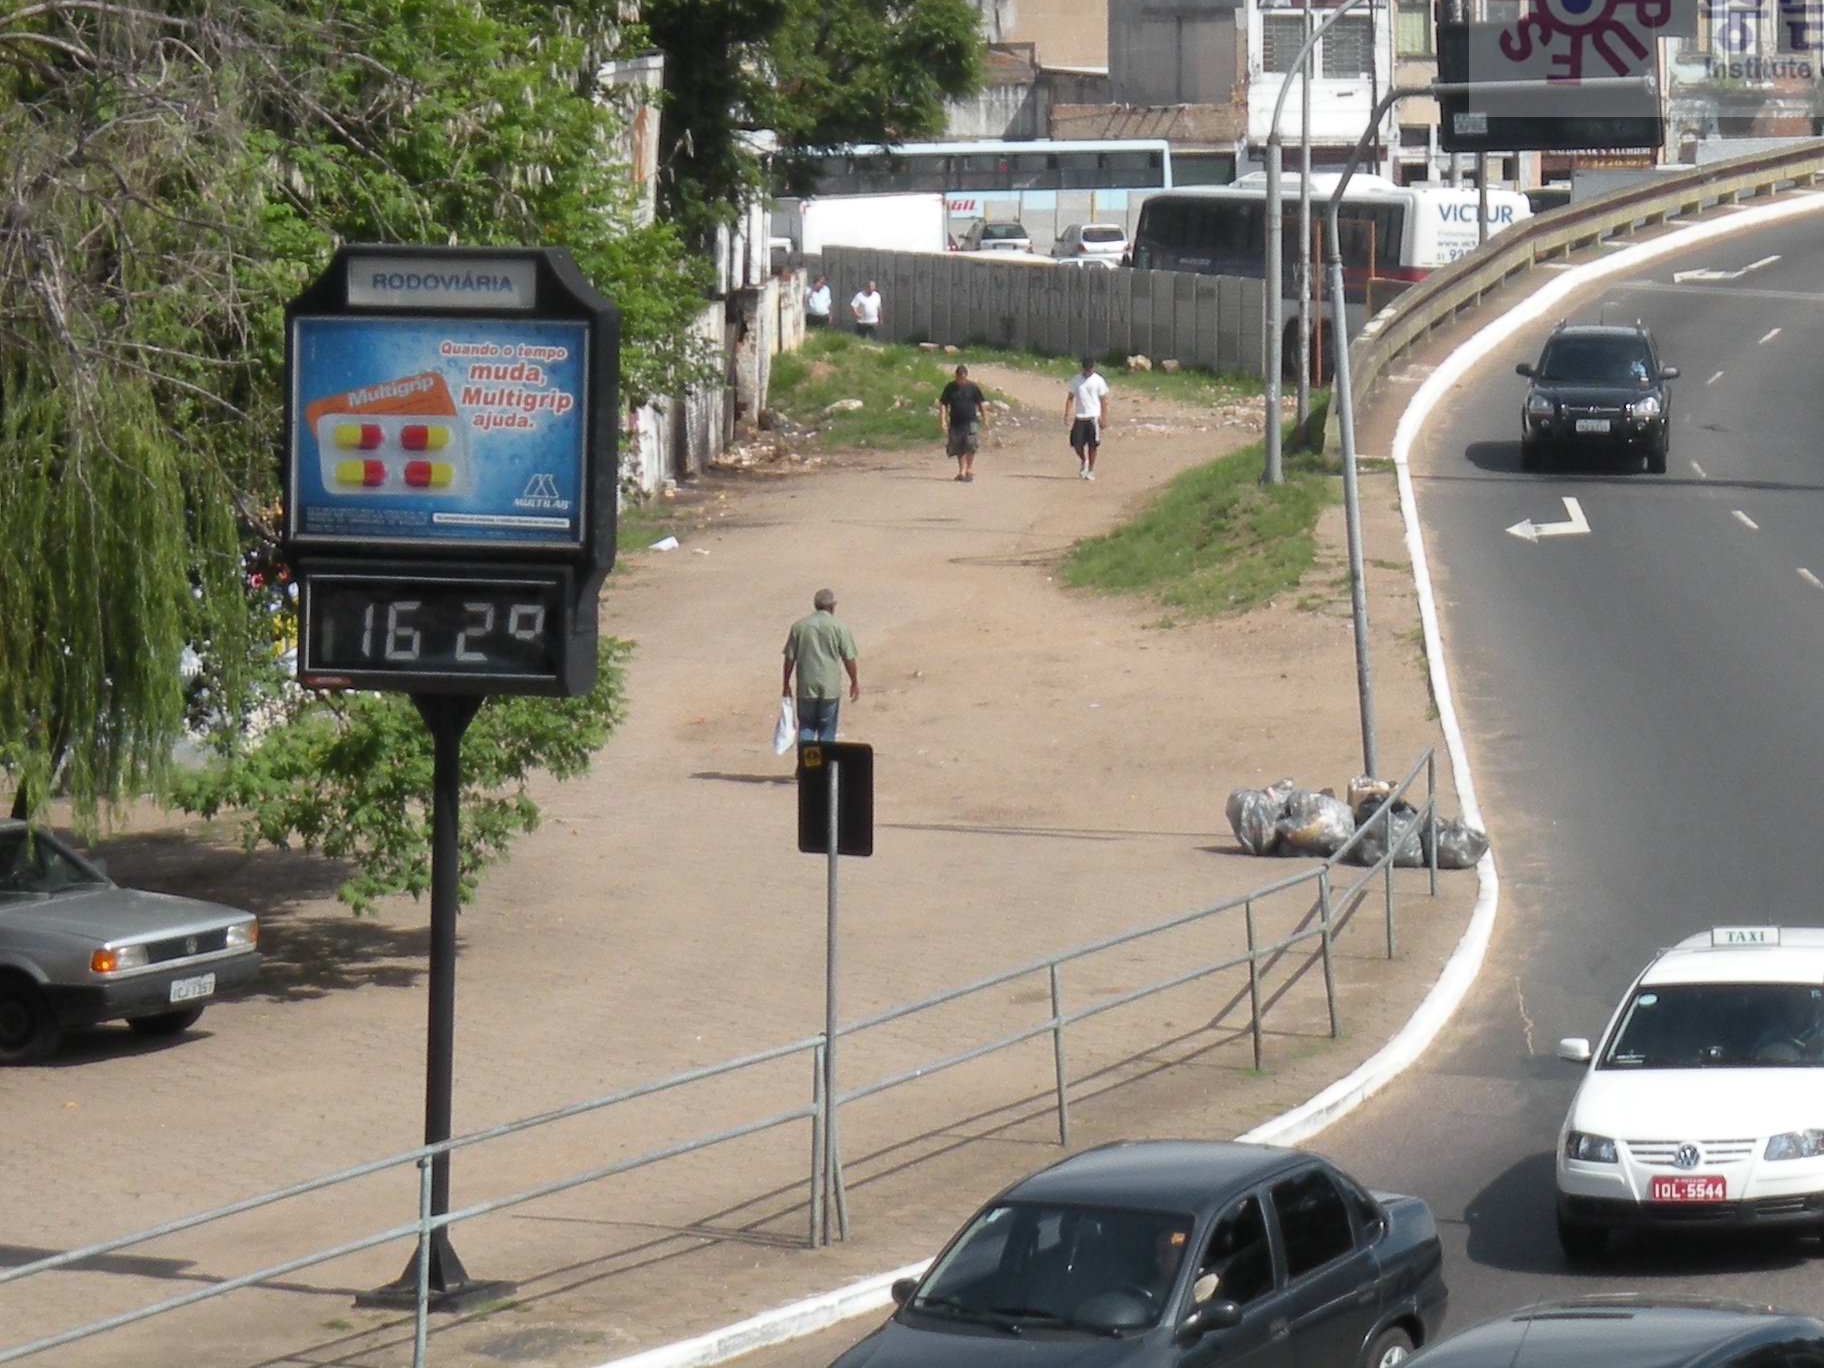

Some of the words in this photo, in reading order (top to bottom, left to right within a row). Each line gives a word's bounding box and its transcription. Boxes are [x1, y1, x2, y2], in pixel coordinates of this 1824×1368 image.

[371, 272, 513, 292] RODOVIÁRIA
[440, 341, 499, 357] Quando
[502, 345, 513, 356] o
[516, 344, 568, 360] tempo
[469, 362, 547, 385] muda,
[347, 377, 434, 408] Multigrip
[461, 386, 574, 415] Multigrip
[472, 412, 535, 431] ajuda.
[513, 497, 572, 511] MULTILAB
[1725, 930, 1765, 942] TAXI
